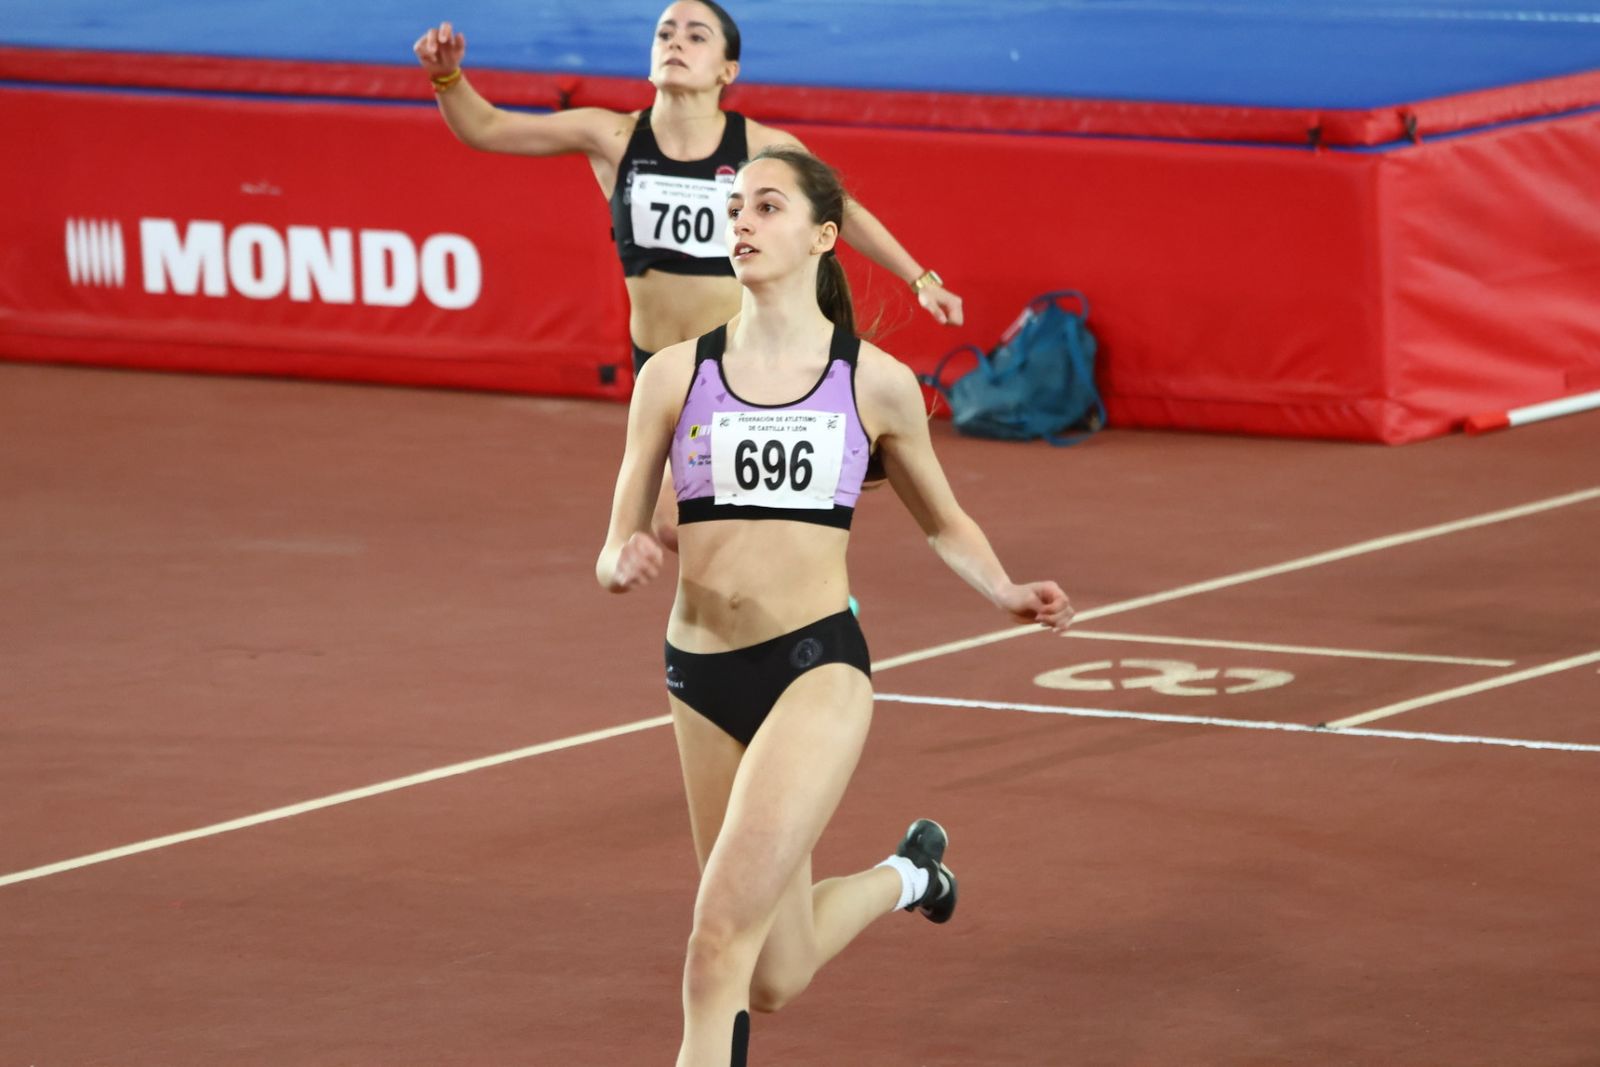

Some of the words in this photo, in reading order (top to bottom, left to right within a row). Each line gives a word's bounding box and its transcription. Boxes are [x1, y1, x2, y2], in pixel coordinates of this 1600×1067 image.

[650, 202, 714, 244] 760
[139, 216, 482, 310] MONDO
[791, 424, 807, 432] LEÓN
[734, 439, 814, 491] 696
